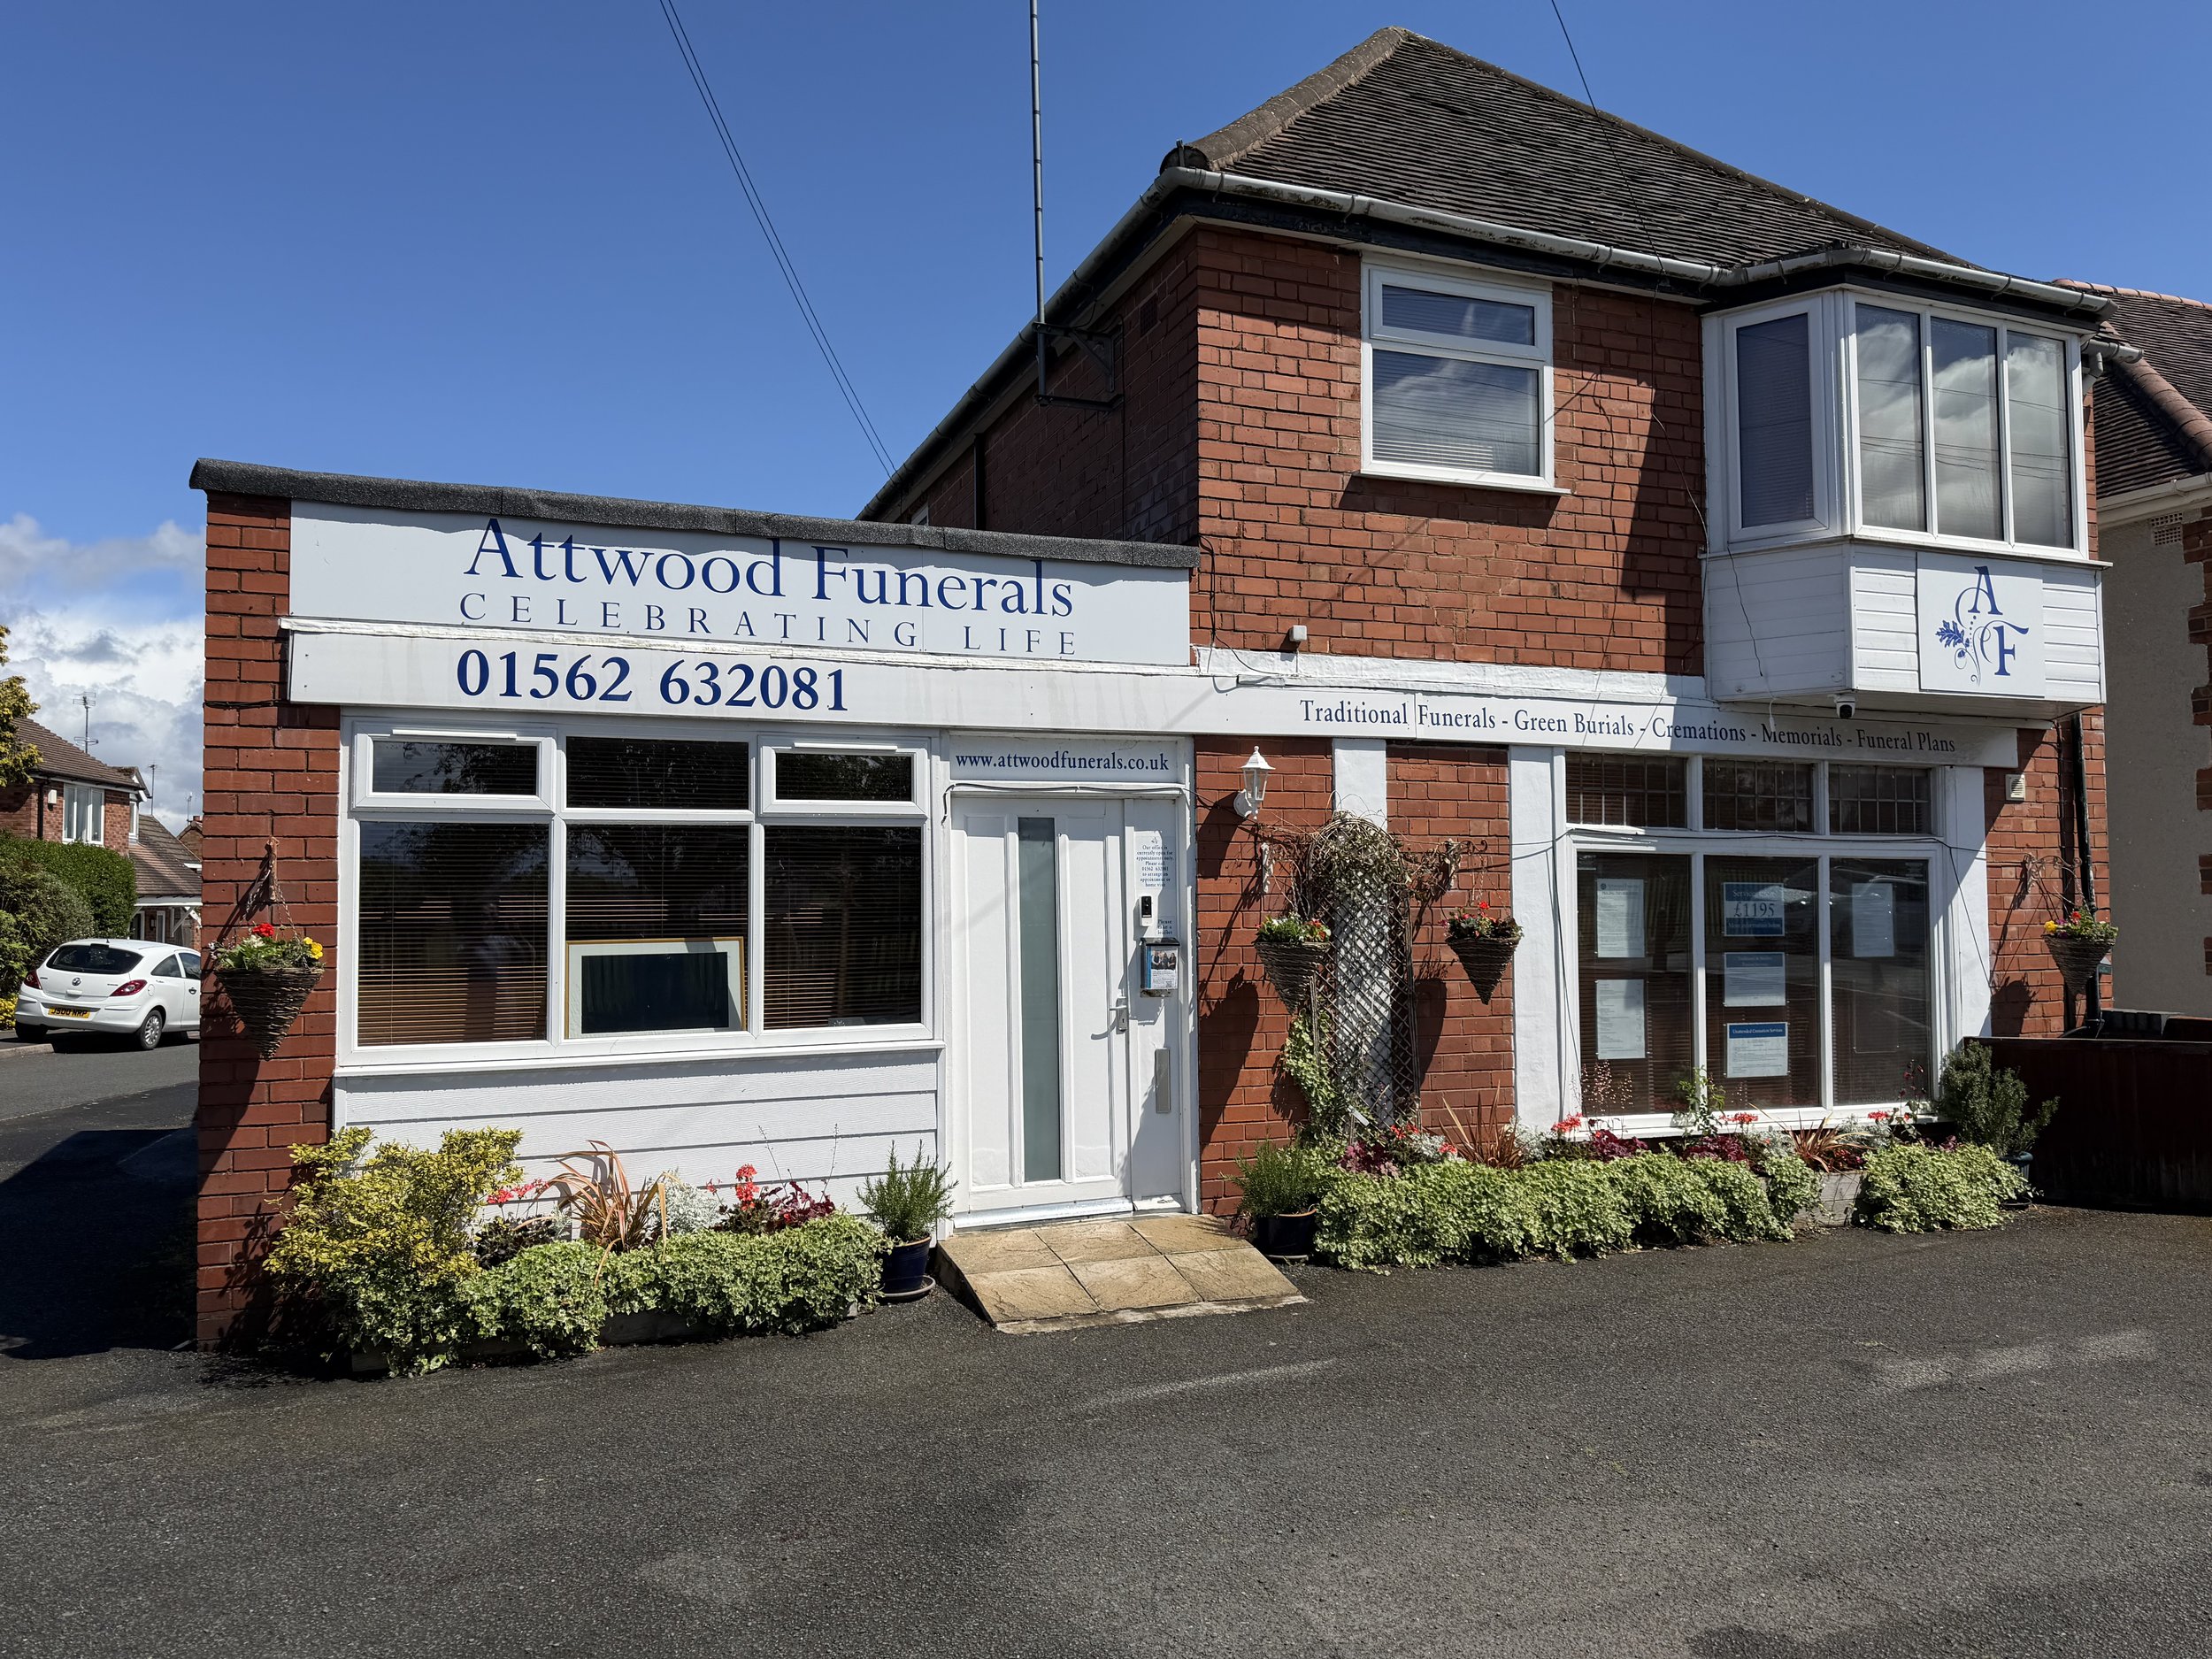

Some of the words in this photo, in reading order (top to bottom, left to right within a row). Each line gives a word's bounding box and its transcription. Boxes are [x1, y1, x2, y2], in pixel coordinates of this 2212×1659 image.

[464, 518, 786, 596] Attwood
[810, 545, 1073, 617] Funerals
[460, 593, 916, 648] CELEBRATING
[963, 626, 1076, 656] LIFE
[457, 649, 634, 703] 01562
[659, 659, 849, 711] 632081
[1300, 699, 1408, 725] Traditional
[1417, 704, 1495, 729] Funerals
[1514, 709, 1567, 733] Green
[1575, 713, 1634, 736] Burials
[1652, 717, 1746, 742] Cremations
[1761, 723, 1842, 748] Memorials
[1856, 728, 1913, 751] Funeral
[1916, 732, 1955, 753] Plans
[956, 750, 1169, 771] www.attwoodfunerals.co.uk
[1733, 902, 1775, 918] £1195
